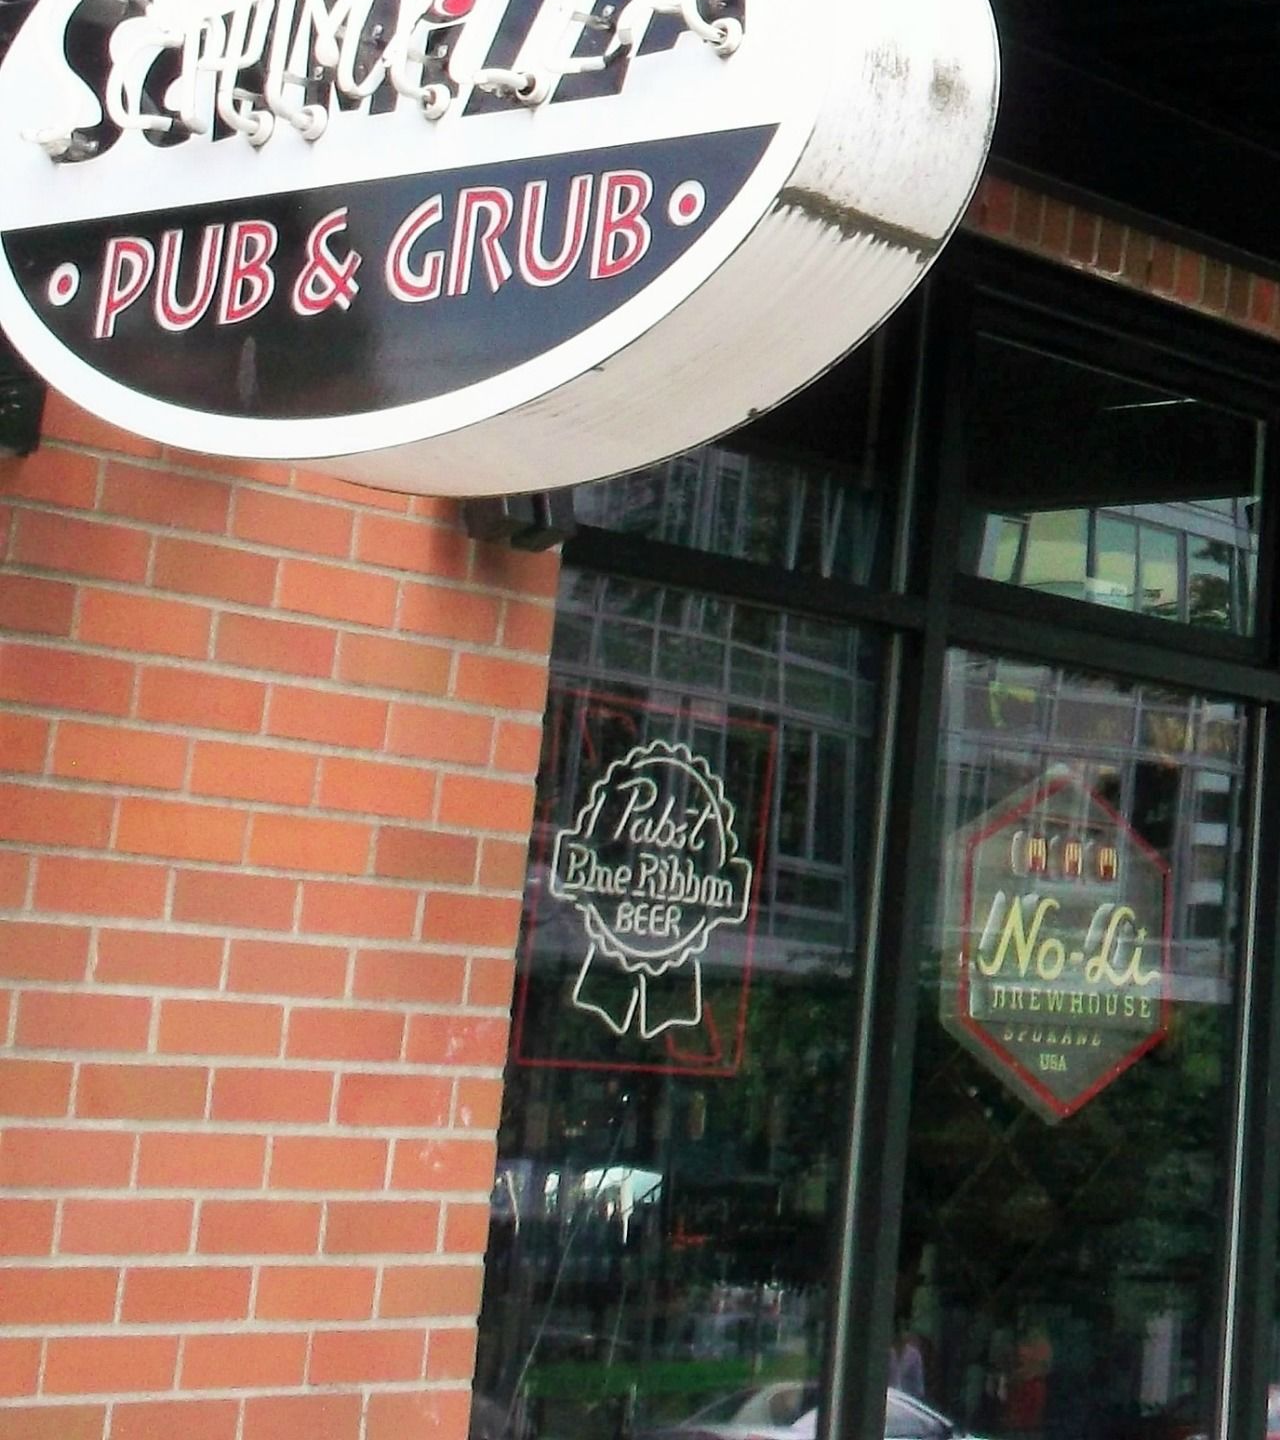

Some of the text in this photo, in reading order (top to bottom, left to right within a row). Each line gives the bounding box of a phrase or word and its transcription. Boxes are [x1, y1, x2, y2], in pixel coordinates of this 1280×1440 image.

[94, 167, 655, 341] PUB & GRUB
[614, 777, 718, 851] Pabst
[562, 842, 734, 908] Blue Ribbon
[615, 901, 682, 939] BEER
[977, 896, 1162, 987] No-Li
[1039, 1053, 1068, 1072] USA
